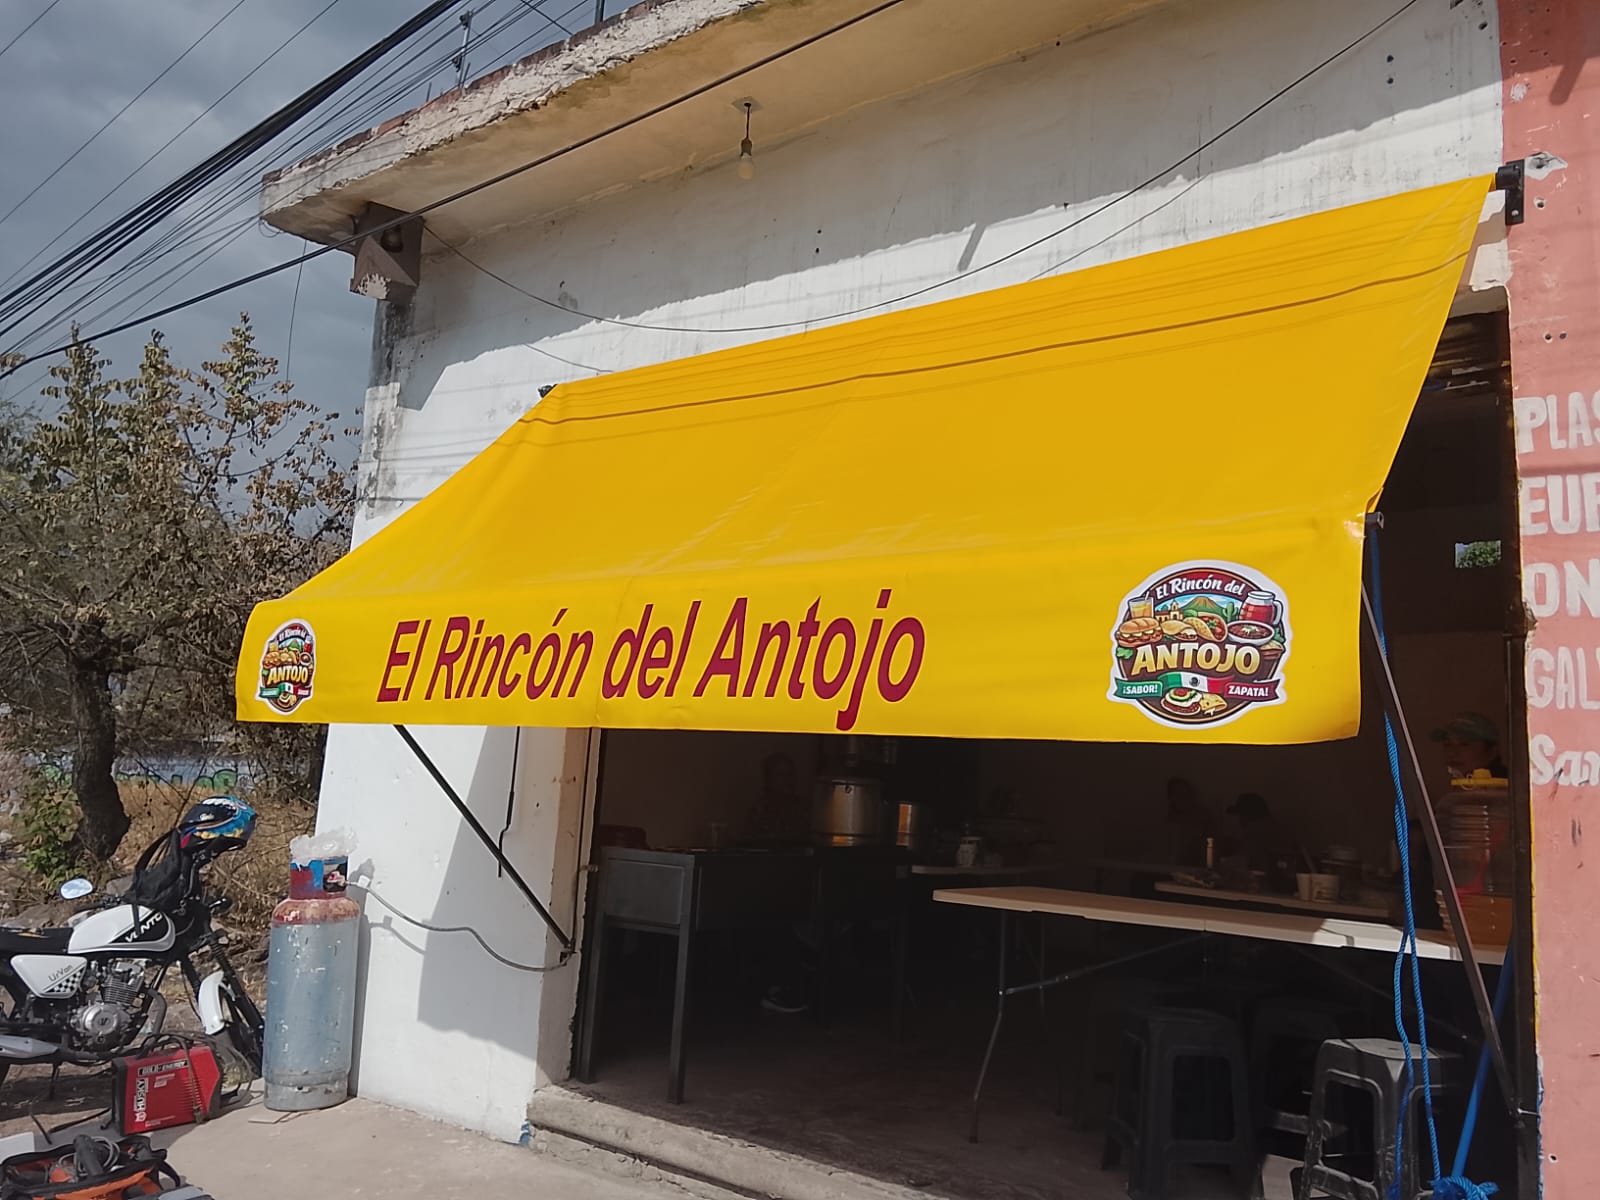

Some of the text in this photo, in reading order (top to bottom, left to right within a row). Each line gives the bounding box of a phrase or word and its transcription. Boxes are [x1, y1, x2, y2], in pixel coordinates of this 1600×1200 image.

[1156, 574, 1244, 600] El Rincón del
[267, 665, 309, 686] ANTOJO
[376, 588, 926, 732] El Rincón del Antojo
[1131, 642, 1261, 676] ANTOJO
[1123, 683, 1269, 698] ¡SABOR! ZAPATA!
[1526, 646, 1600, 710] GAL
[136, 1079, 147, 1113] HUSKY
